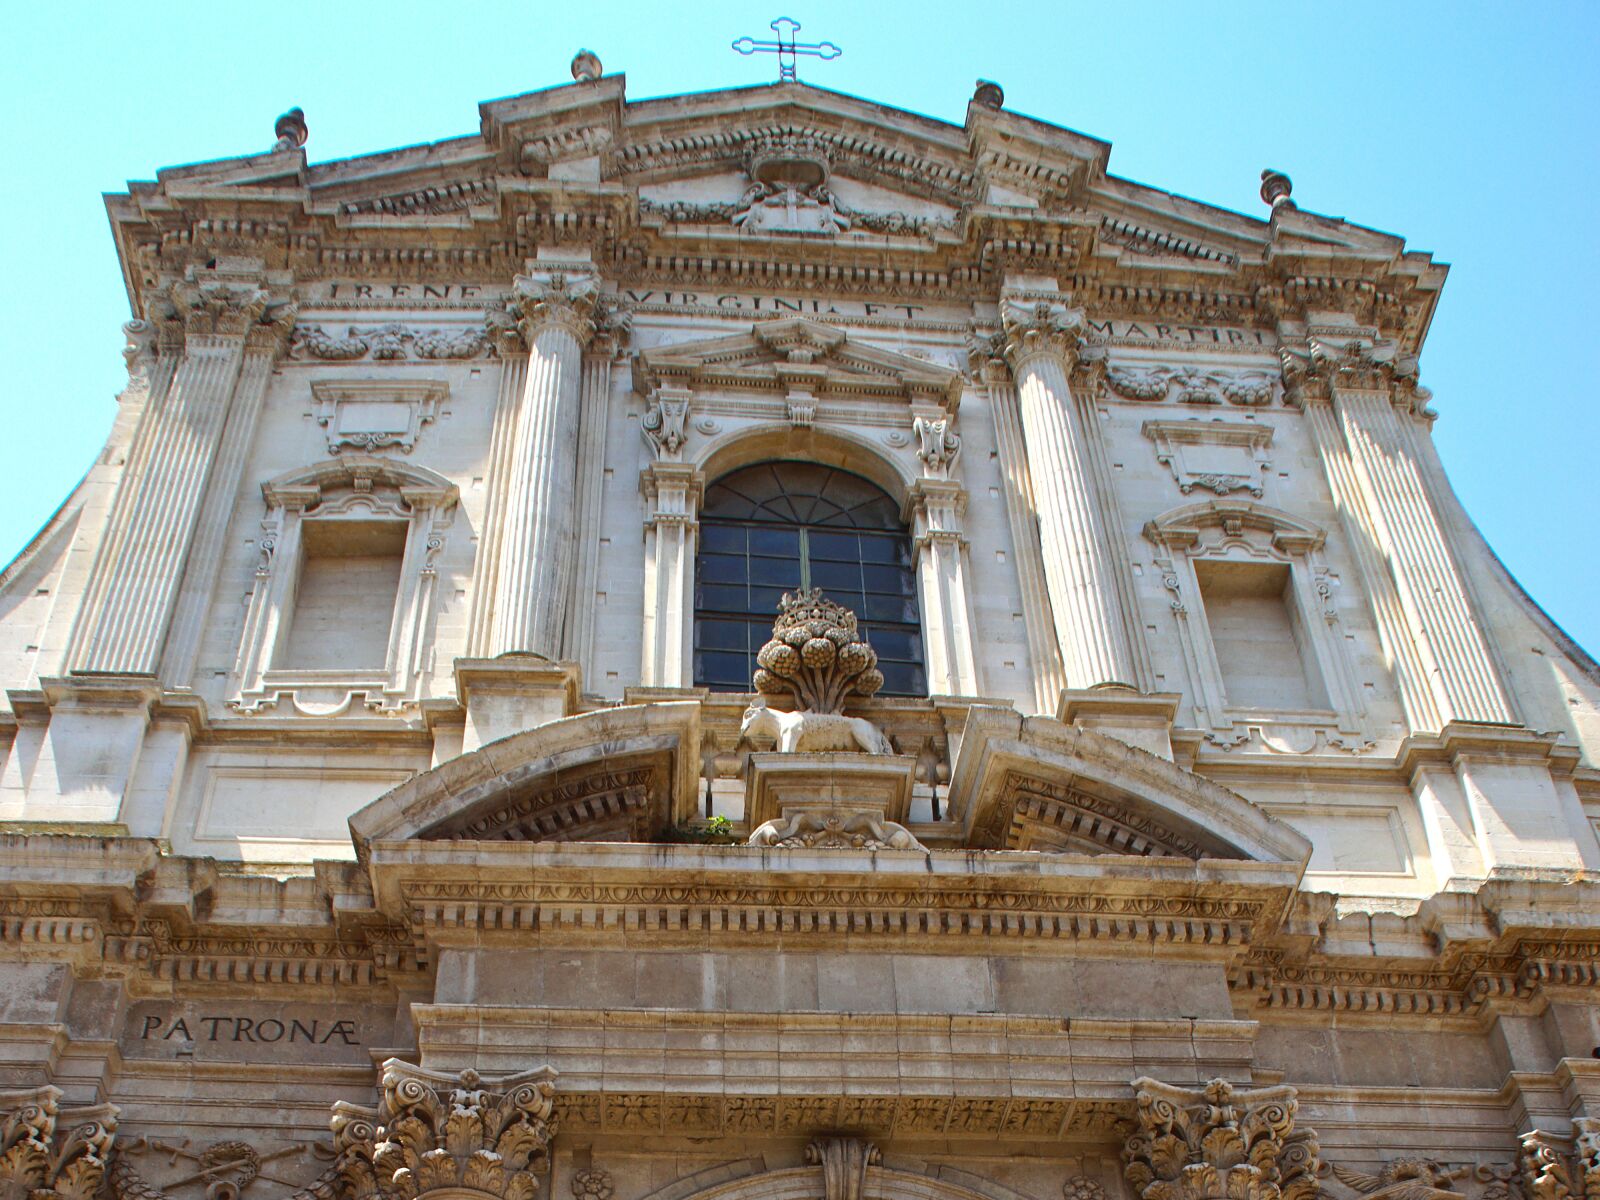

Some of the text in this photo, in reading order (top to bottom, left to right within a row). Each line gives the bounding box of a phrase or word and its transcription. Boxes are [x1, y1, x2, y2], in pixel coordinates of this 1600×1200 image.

[331, 284, 482, 299] IRENE
[864, 302, 924, 319] ET
[1087, 319, 1263, 345] MARTIRI
[141, 1016, 361, 1045] PATRONÆ
